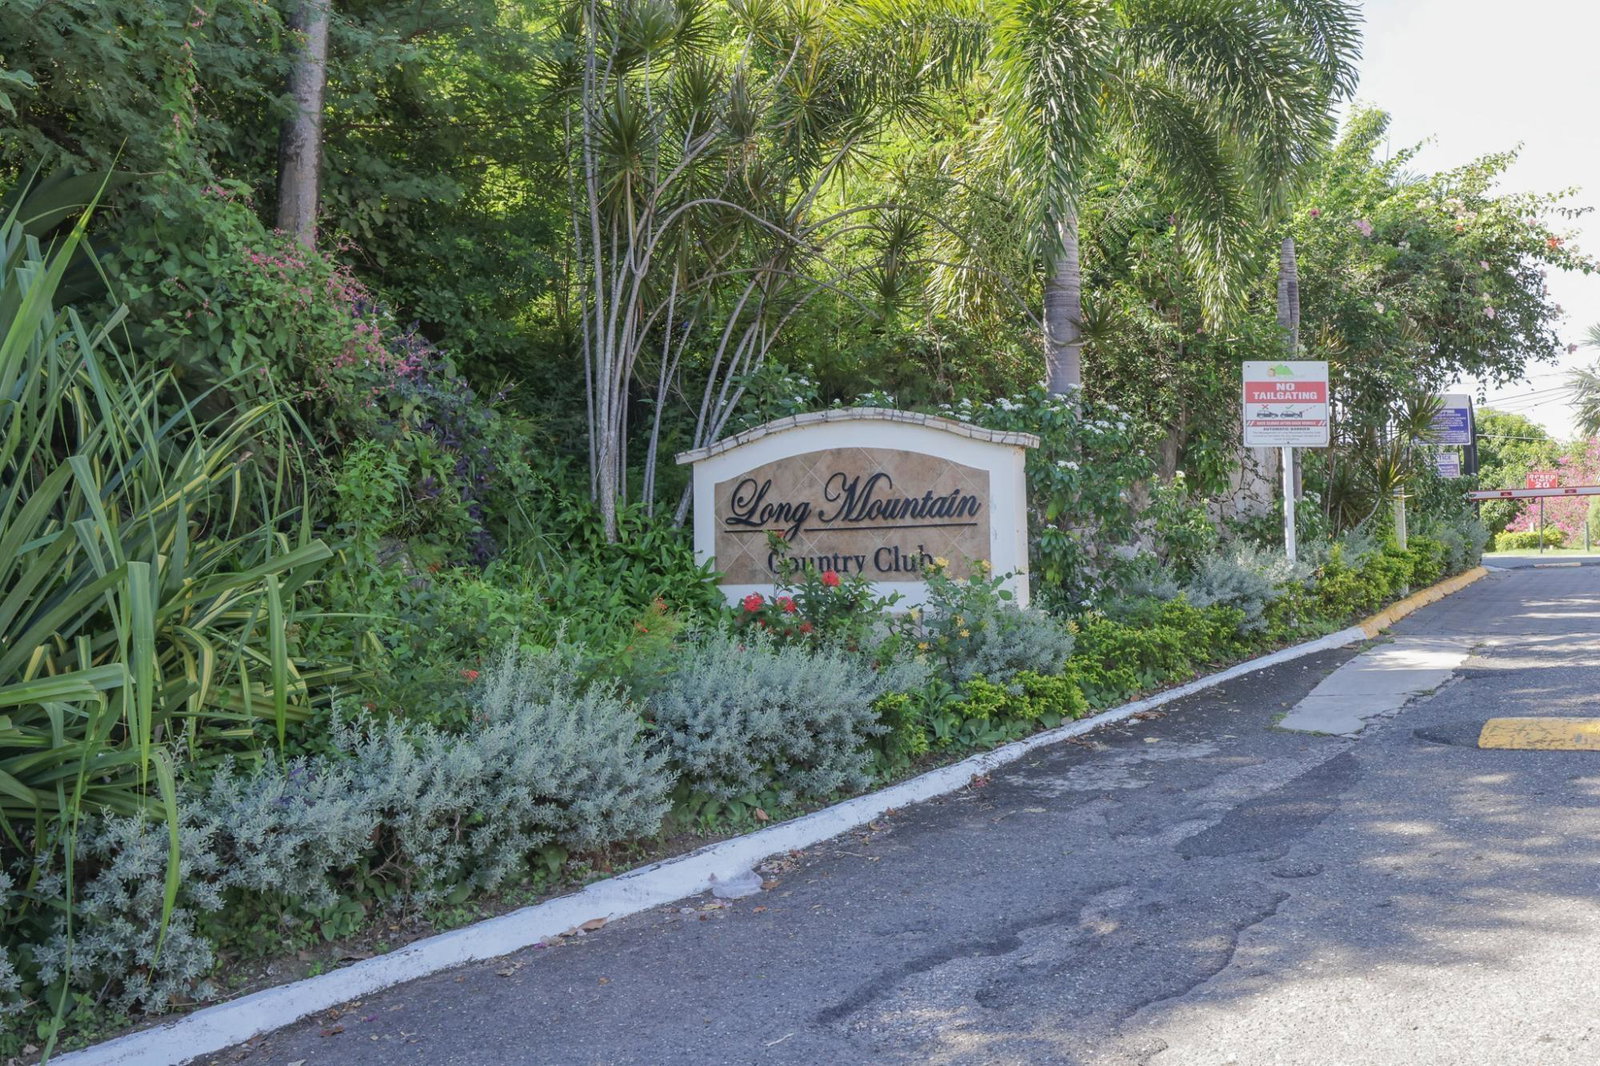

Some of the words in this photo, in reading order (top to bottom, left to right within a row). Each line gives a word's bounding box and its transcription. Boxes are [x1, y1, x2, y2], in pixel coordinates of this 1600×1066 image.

[1253, 392, 1317, 400] TAILGATING
[1276, 383, 1295, 391] NO
[725, 477, 812, 541] Long
[818, 472, 982, 523] Mountain
[874, 545, 934, 573] Club
